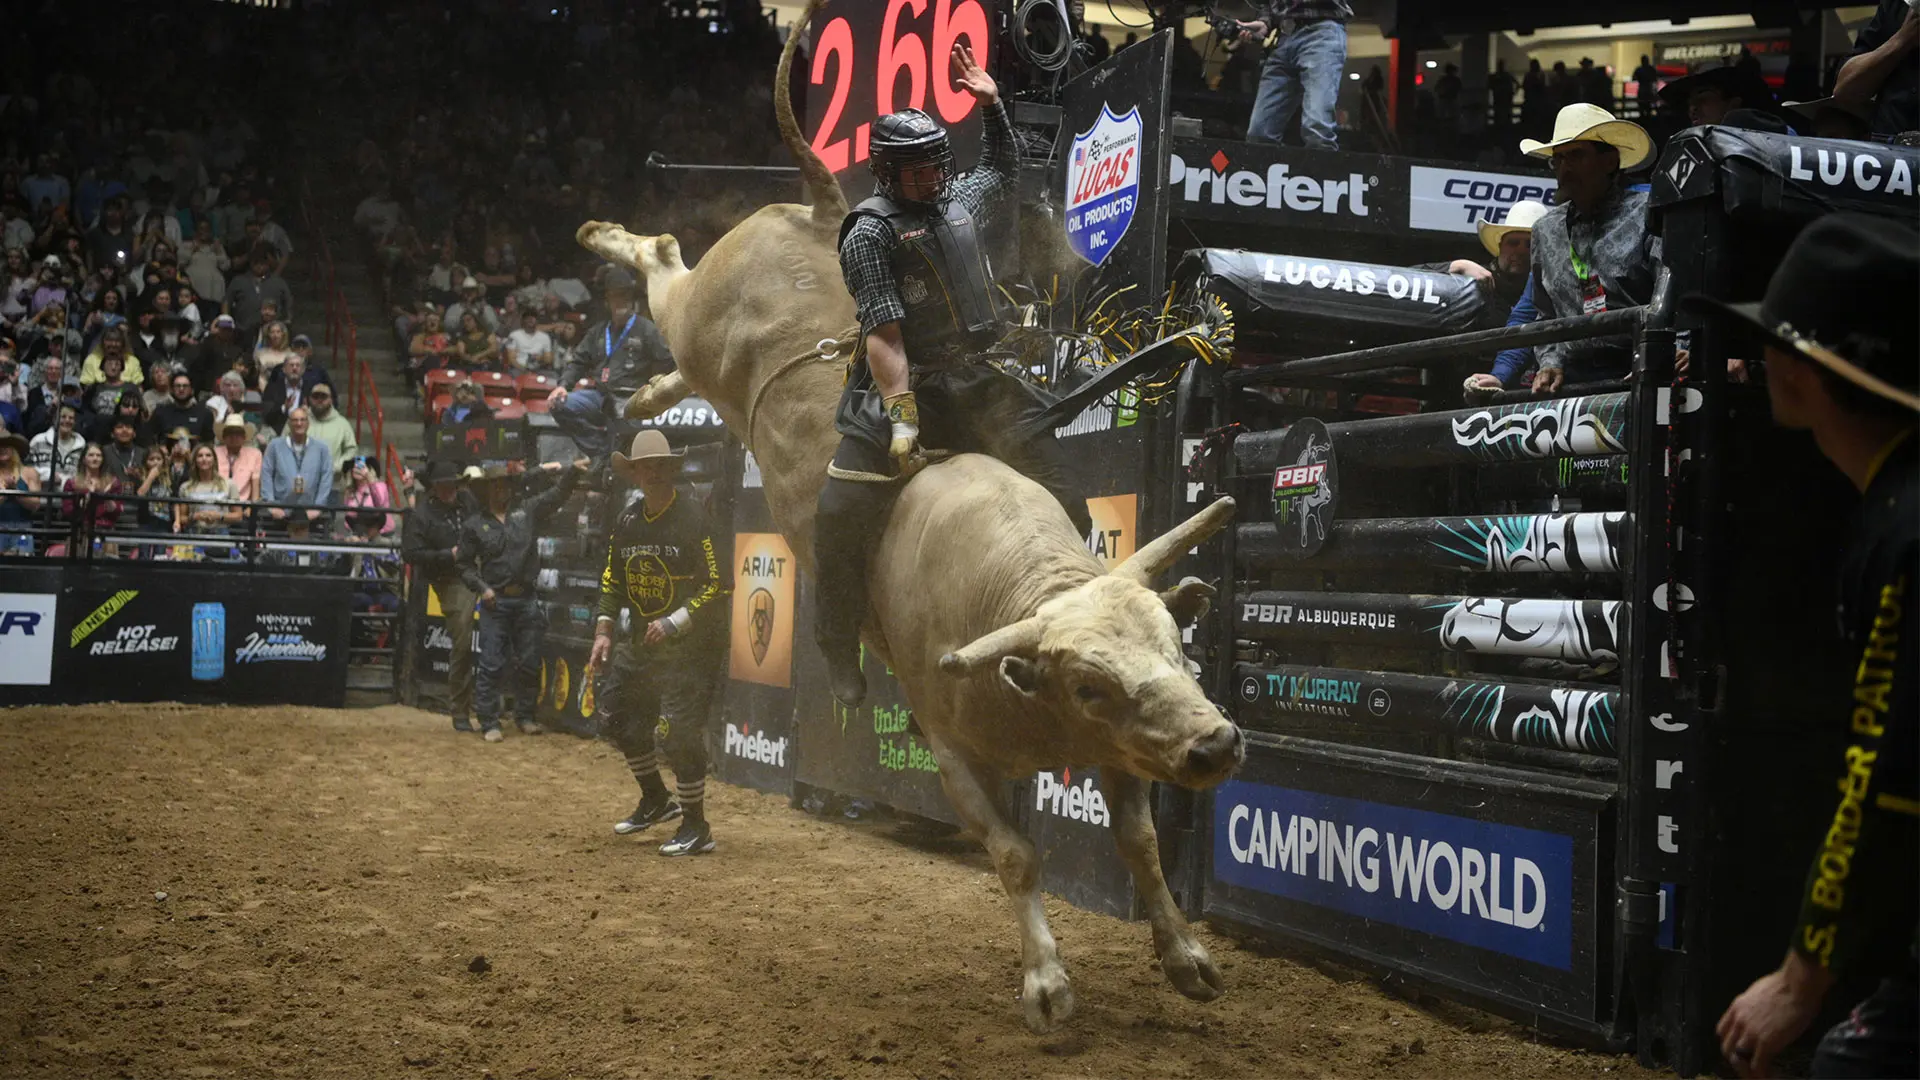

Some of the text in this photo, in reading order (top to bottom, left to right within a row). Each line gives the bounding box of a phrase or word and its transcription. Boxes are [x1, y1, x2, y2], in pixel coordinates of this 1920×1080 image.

[1103, 132, 1137, 154] PERFORMANCE
[1073, 147, 1134, 204] LUCAS
[1790, 146, 1920, 196] LUCA
[1443, 178, 1557, 206] COOPE
[1068, 194, 1132, 233] OIL PRODUCTS
[1090, 229, 1108, 250] INC.
[1263, 258, 1376, 296] LUCAS
[1276, 464, 1325, 488] PBR
[665, 545, 681, 557] BY
[701, 536, 720, 579] PATROL
[741, 556, 787, 578] ARIAT
[85, 602, 114, 629] NEW
[256, 613, 313, 626] MONSTER
[1242, 603, 1396, 629] PBR ALBUQUERQUE
[116, 624, 156, 640] HOT
[267, 633, 304, 644] BLUE
[89, 636, 178, 656] RELEASE!
[235, 632, 327, 664] Hawaiian
[1245, 685, 1255, 694] 20
[1266, 674, 1361, 704] TY MURRAY
[1275, 700, 1351, 717] INVTATIONAL
[725, 724, 786, 768] Priefert
[879, 736, 941, 773] the Beas
[1811, 744, 1878, 910] BORDER
[1851, 576, 1906, 737] PATROL
[1228, 803, 1547, 930] CAMPING WORLD
